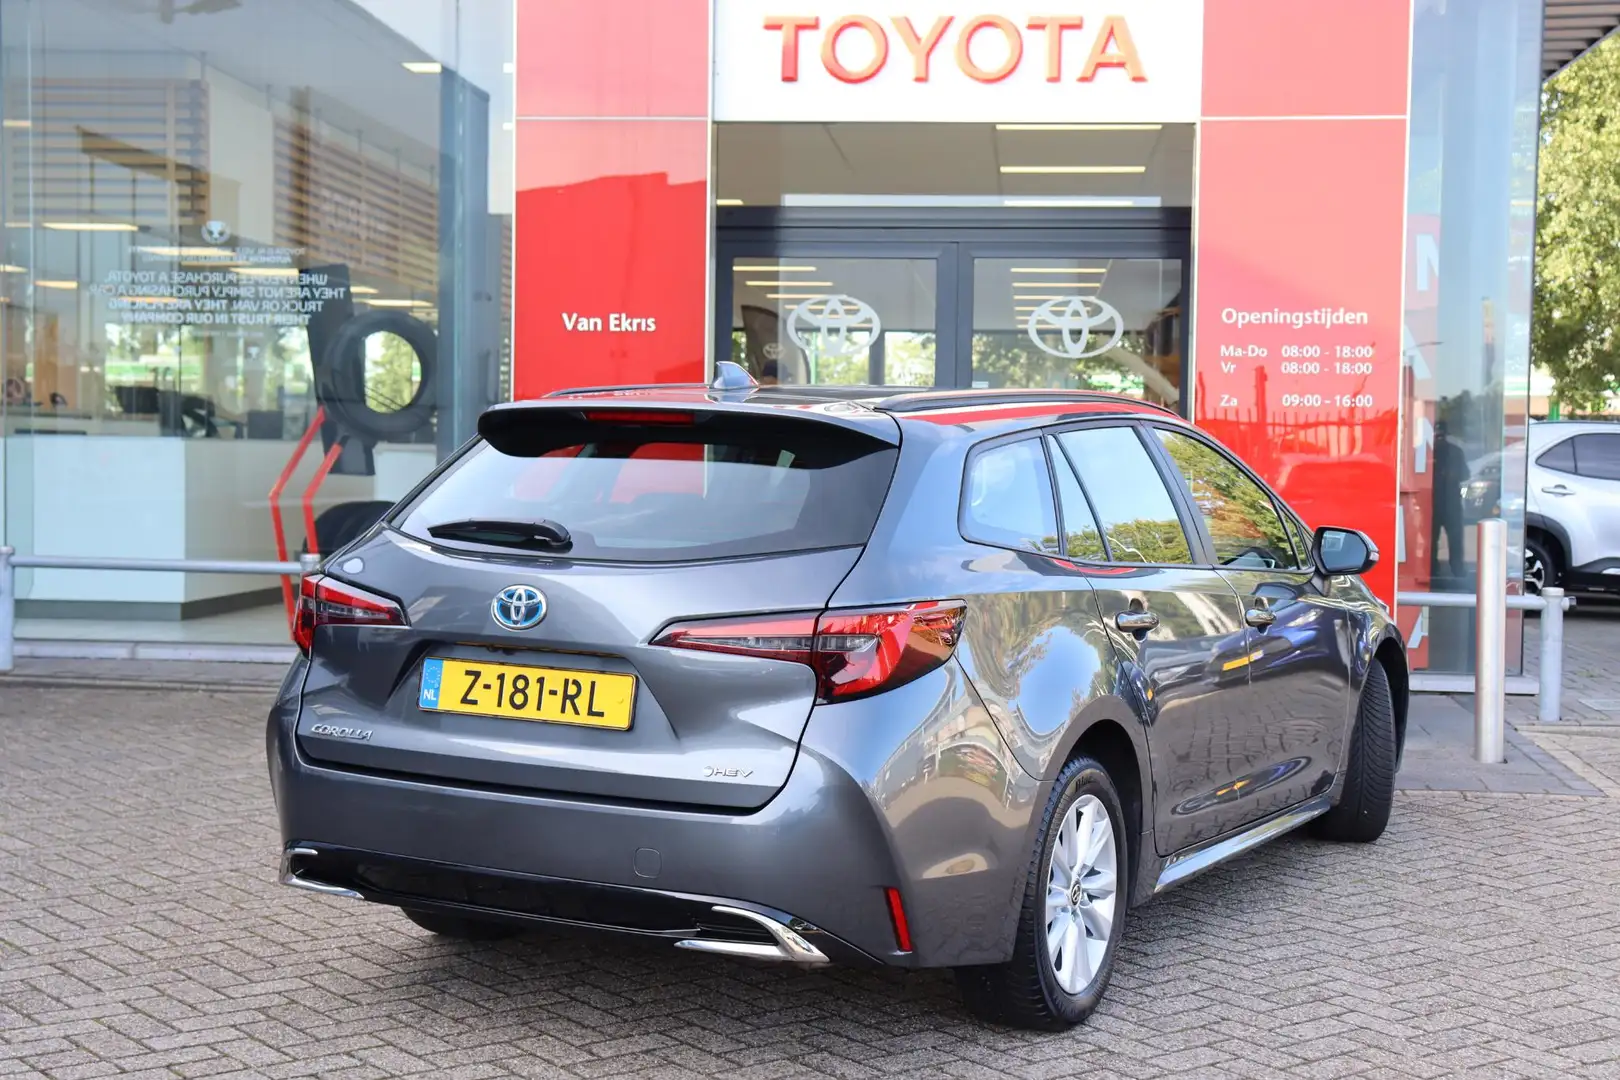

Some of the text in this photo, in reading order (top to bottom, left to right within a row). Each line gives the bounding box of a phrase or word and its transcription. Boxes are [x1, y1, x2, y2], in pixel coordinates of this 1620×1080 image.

[763, 14, 1148, 84] TOYOTA
[562, 312, 656, 332] Van Ekris
[1221, 308, 1368, 329] Openingstijden
[1220, 345, 1267, 357] Ma-Do
[1281, 345, 1320, 358] 08:00
[1334, 345, 1373, 358] 18:00
[1221, 362, 1236, 374] Vr
[1281, 362, 1320, 374] 08:00
[1334, 362, 1372, 374] 18:00
[1220, 394, 1238, 407] Za
[1282, 394, 1321, 407] 09:00
[1335, 394, 1373, 407] 16:00
[423, 669, 605, 718] NL Z-181-RL
[311, 723, 374, 742] COROLLA
[714, 767, 754, 779] HEV
